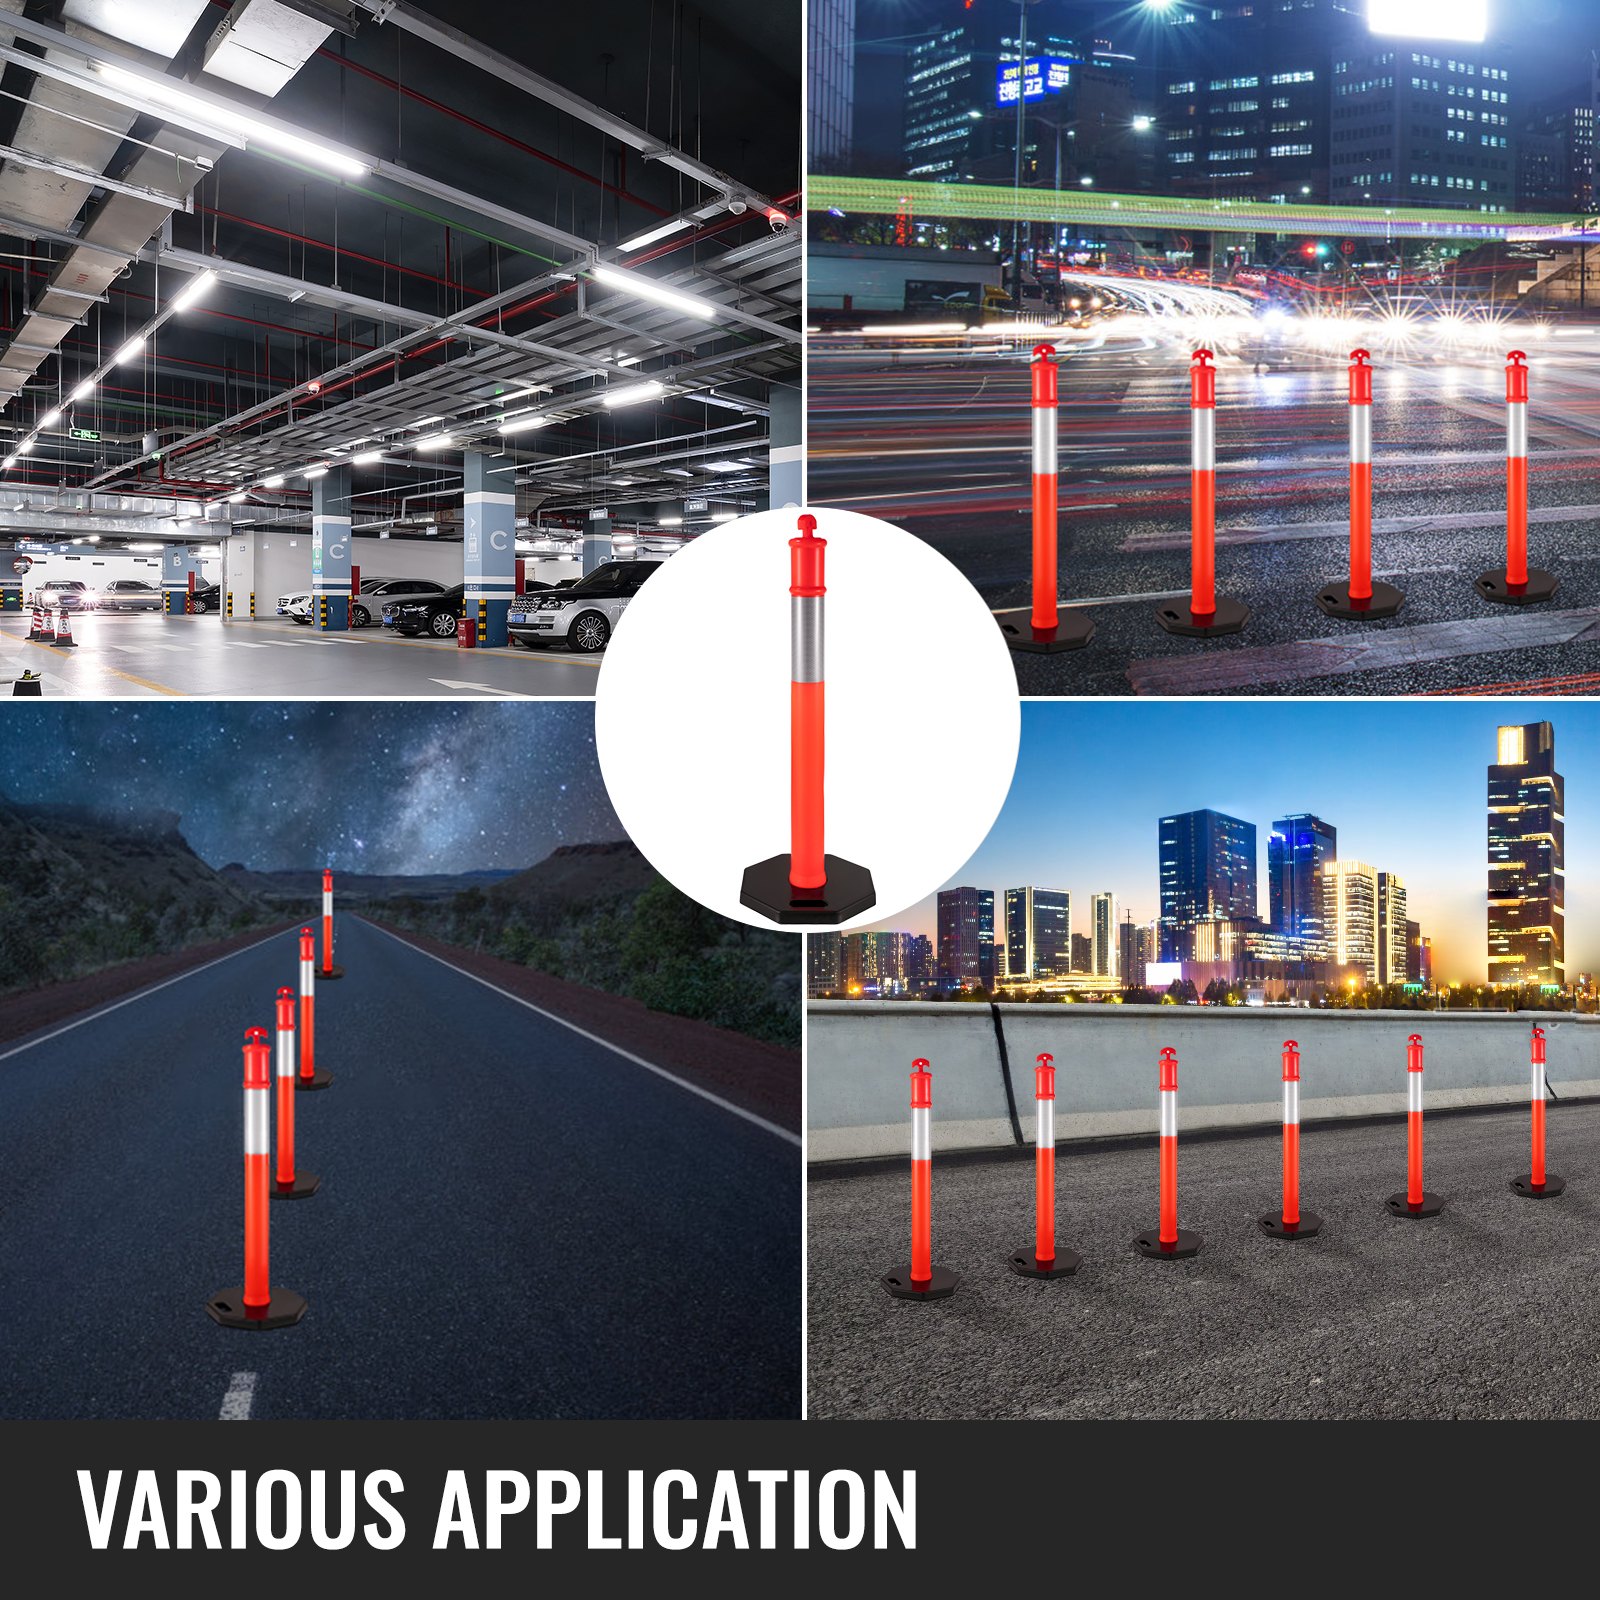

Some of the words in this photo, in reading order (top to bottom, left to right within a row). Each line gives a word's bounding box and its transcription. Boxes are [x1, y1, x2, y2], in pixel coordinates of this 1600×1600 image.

[490, 530, 508, 551] C
[329, 544, 345, 560] C
[173, 556, 182, 567] B
